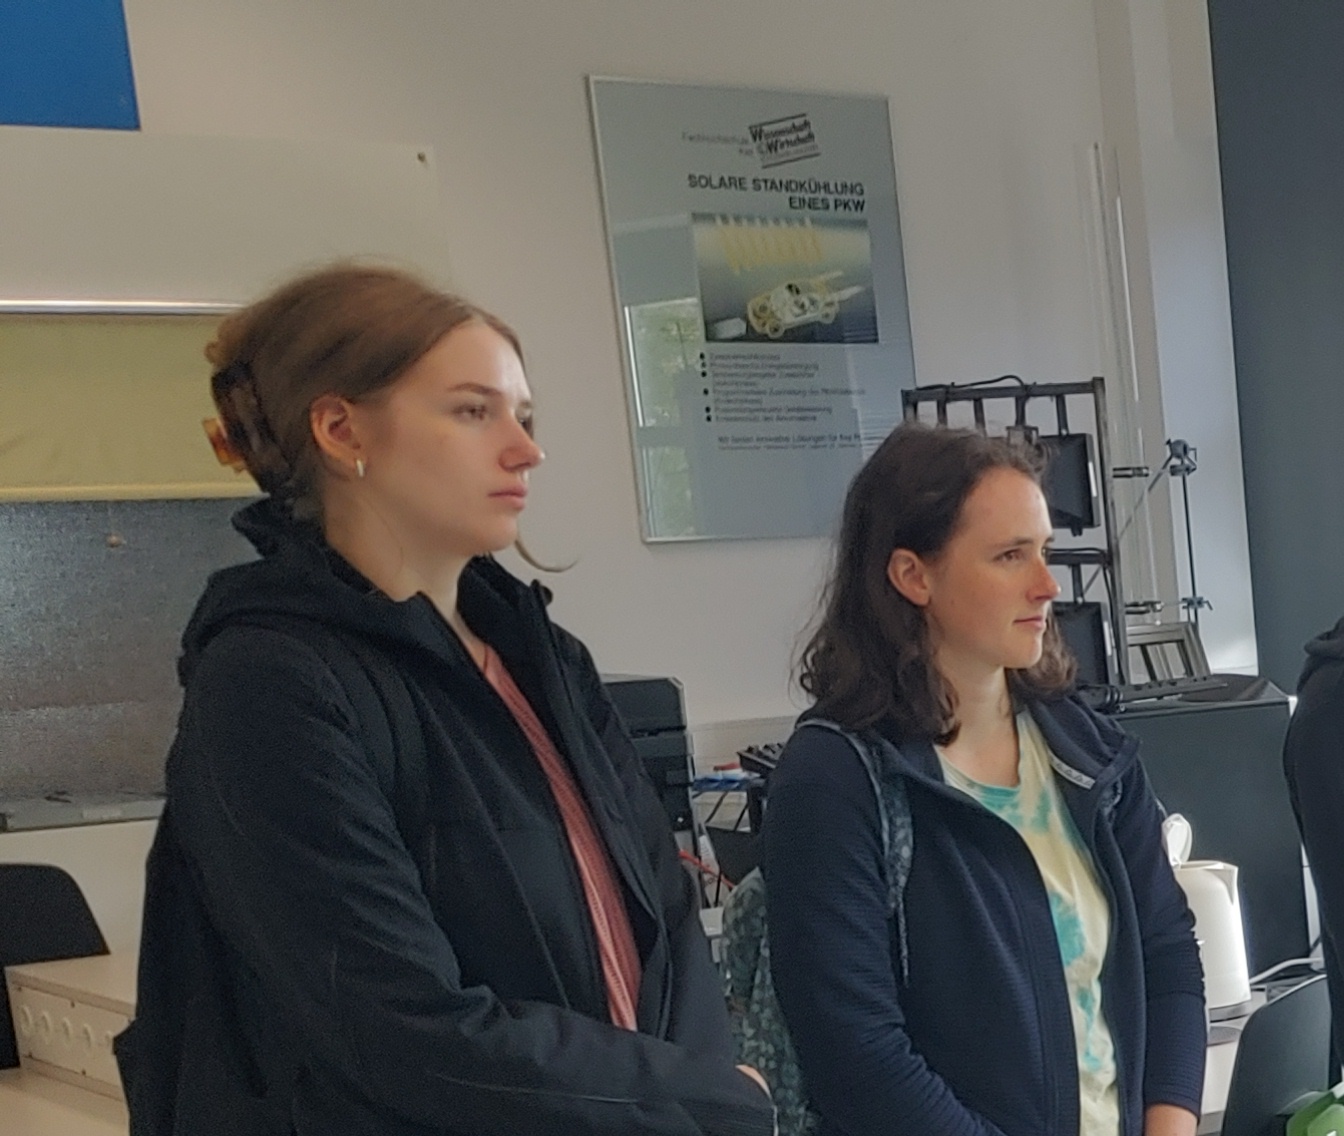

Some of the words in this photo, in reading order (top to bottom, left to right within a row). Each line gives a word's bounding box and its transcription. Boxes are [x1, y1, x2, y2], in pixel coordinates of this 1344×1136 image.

[688, 174, 748, 191] SOLARE
[752, 177, 865, 196] STANDKÜHLUNG
[788, 196, 830, 210] EINES
[834, 199, 866, 212] PKW
